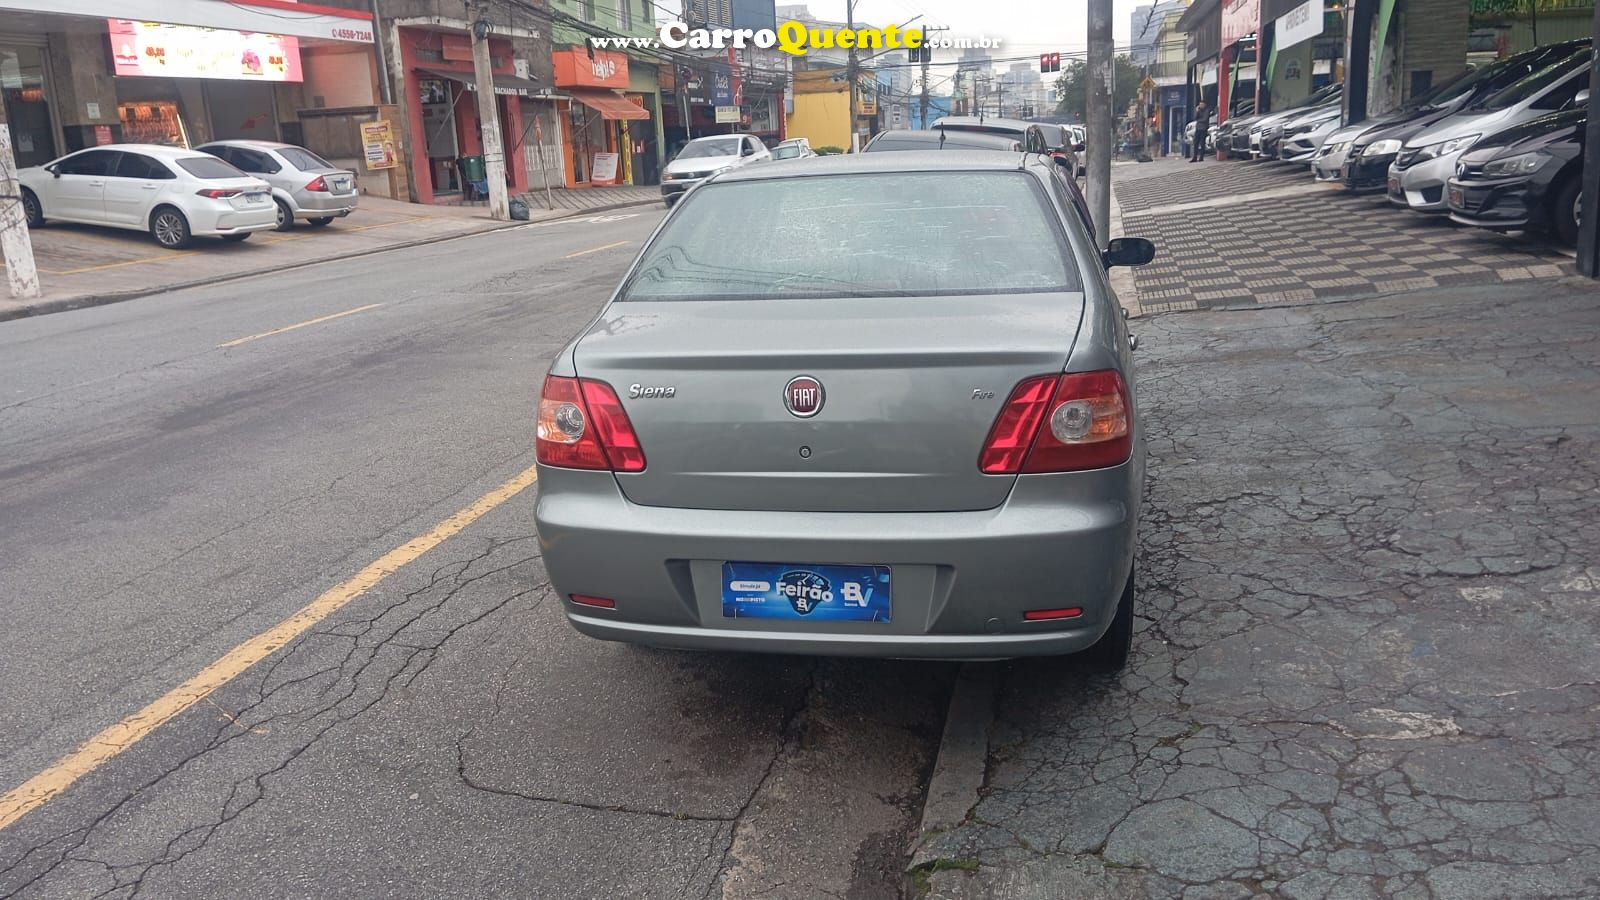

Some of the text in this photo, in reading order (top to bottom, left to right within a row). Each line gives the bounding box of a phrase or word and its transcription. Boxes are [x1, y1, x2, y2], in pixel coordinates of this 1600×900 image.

[629, 383, 676, 400] Siena
[793, 388, 815, 407] FIAT
[971, 388, 994, 400] Fire
[775, 580, 834, 603] Feirão
[840, 582, 874, 607] BV
